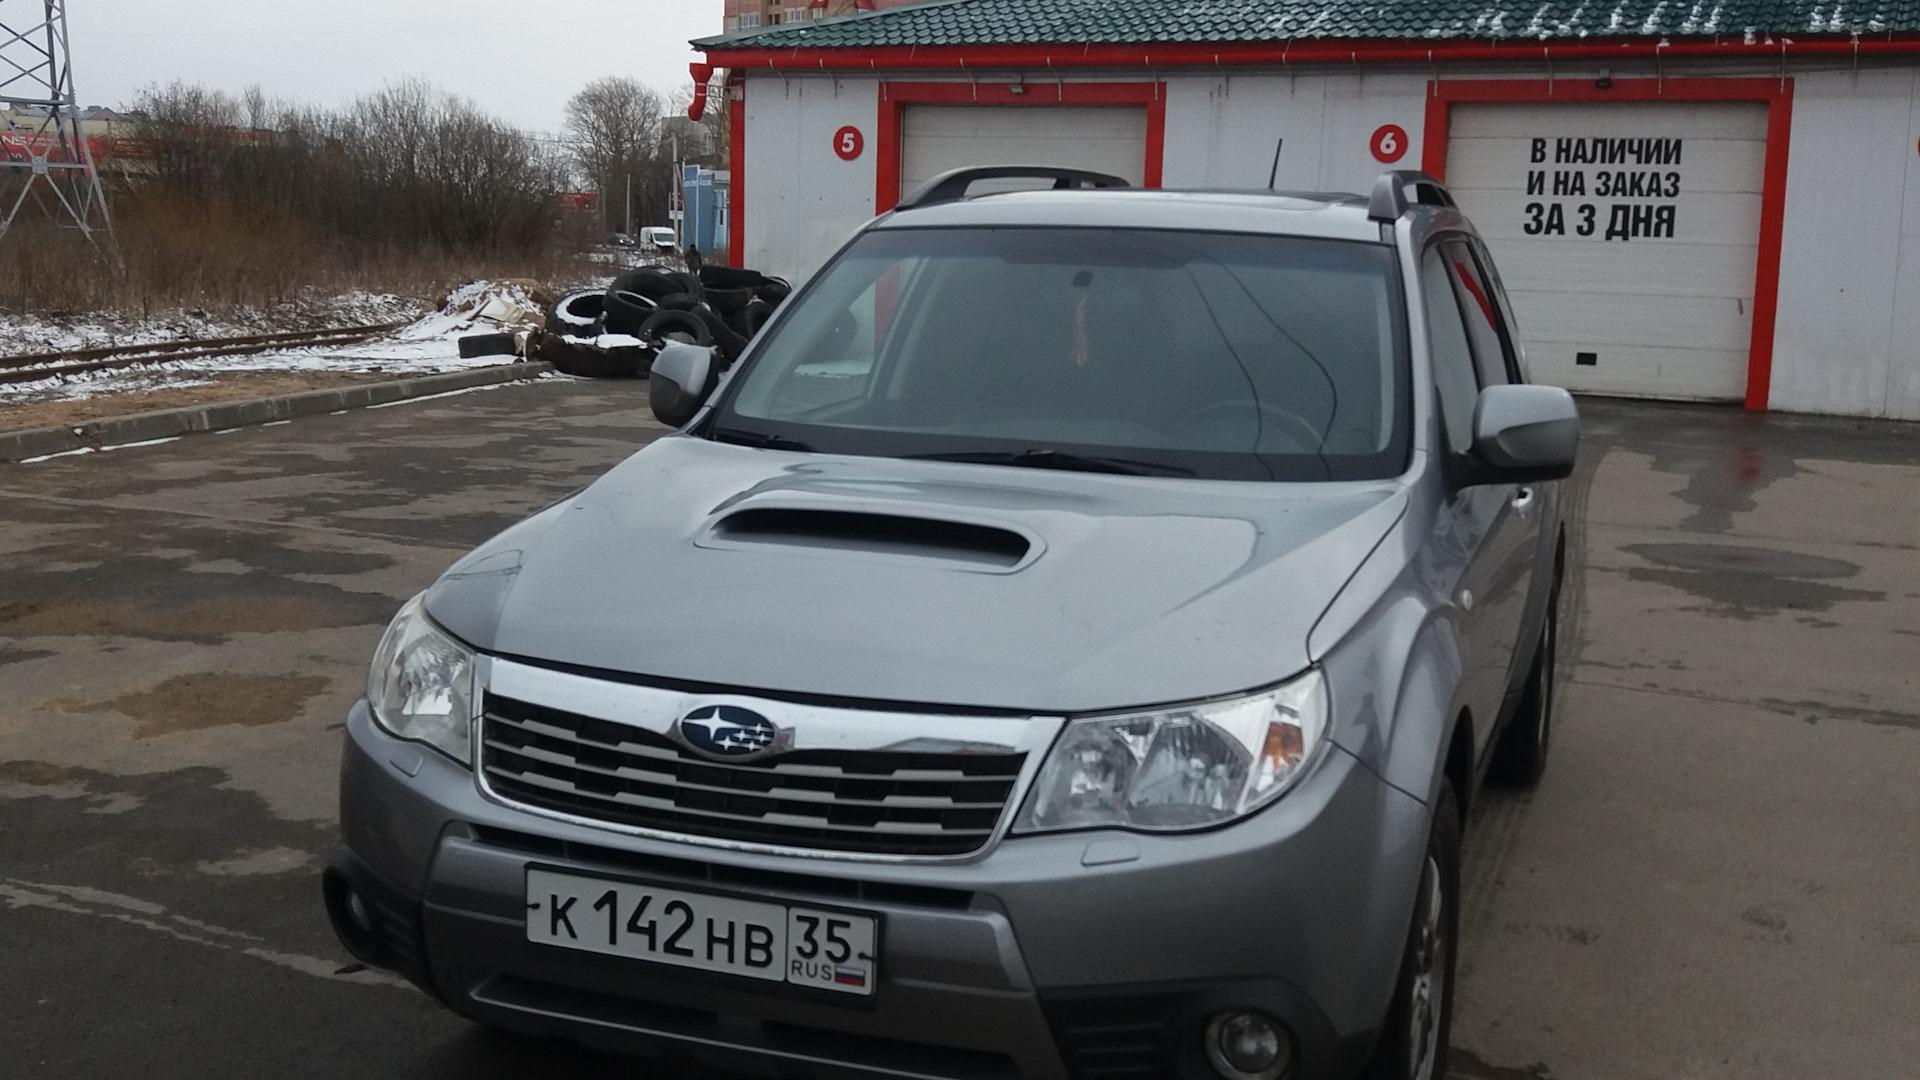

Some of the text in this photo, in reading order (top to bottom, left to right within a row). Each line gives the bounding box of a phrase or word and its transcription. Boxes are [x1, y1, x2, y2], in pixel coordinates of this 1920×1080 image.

[841, 132, 855, 153] 5
[1379, 132, 1397, 154] 6
[1530, 137, 1682, 165] В НАЛИЧИИ
[1527, 170, 1681, 198] И НА ЗАКАЗ
[1524, 202, 1676, 241] ЗА 3 ДНЯ
[795, 915, 851, 963] 35
[791, 960, 833, 980] RUS
